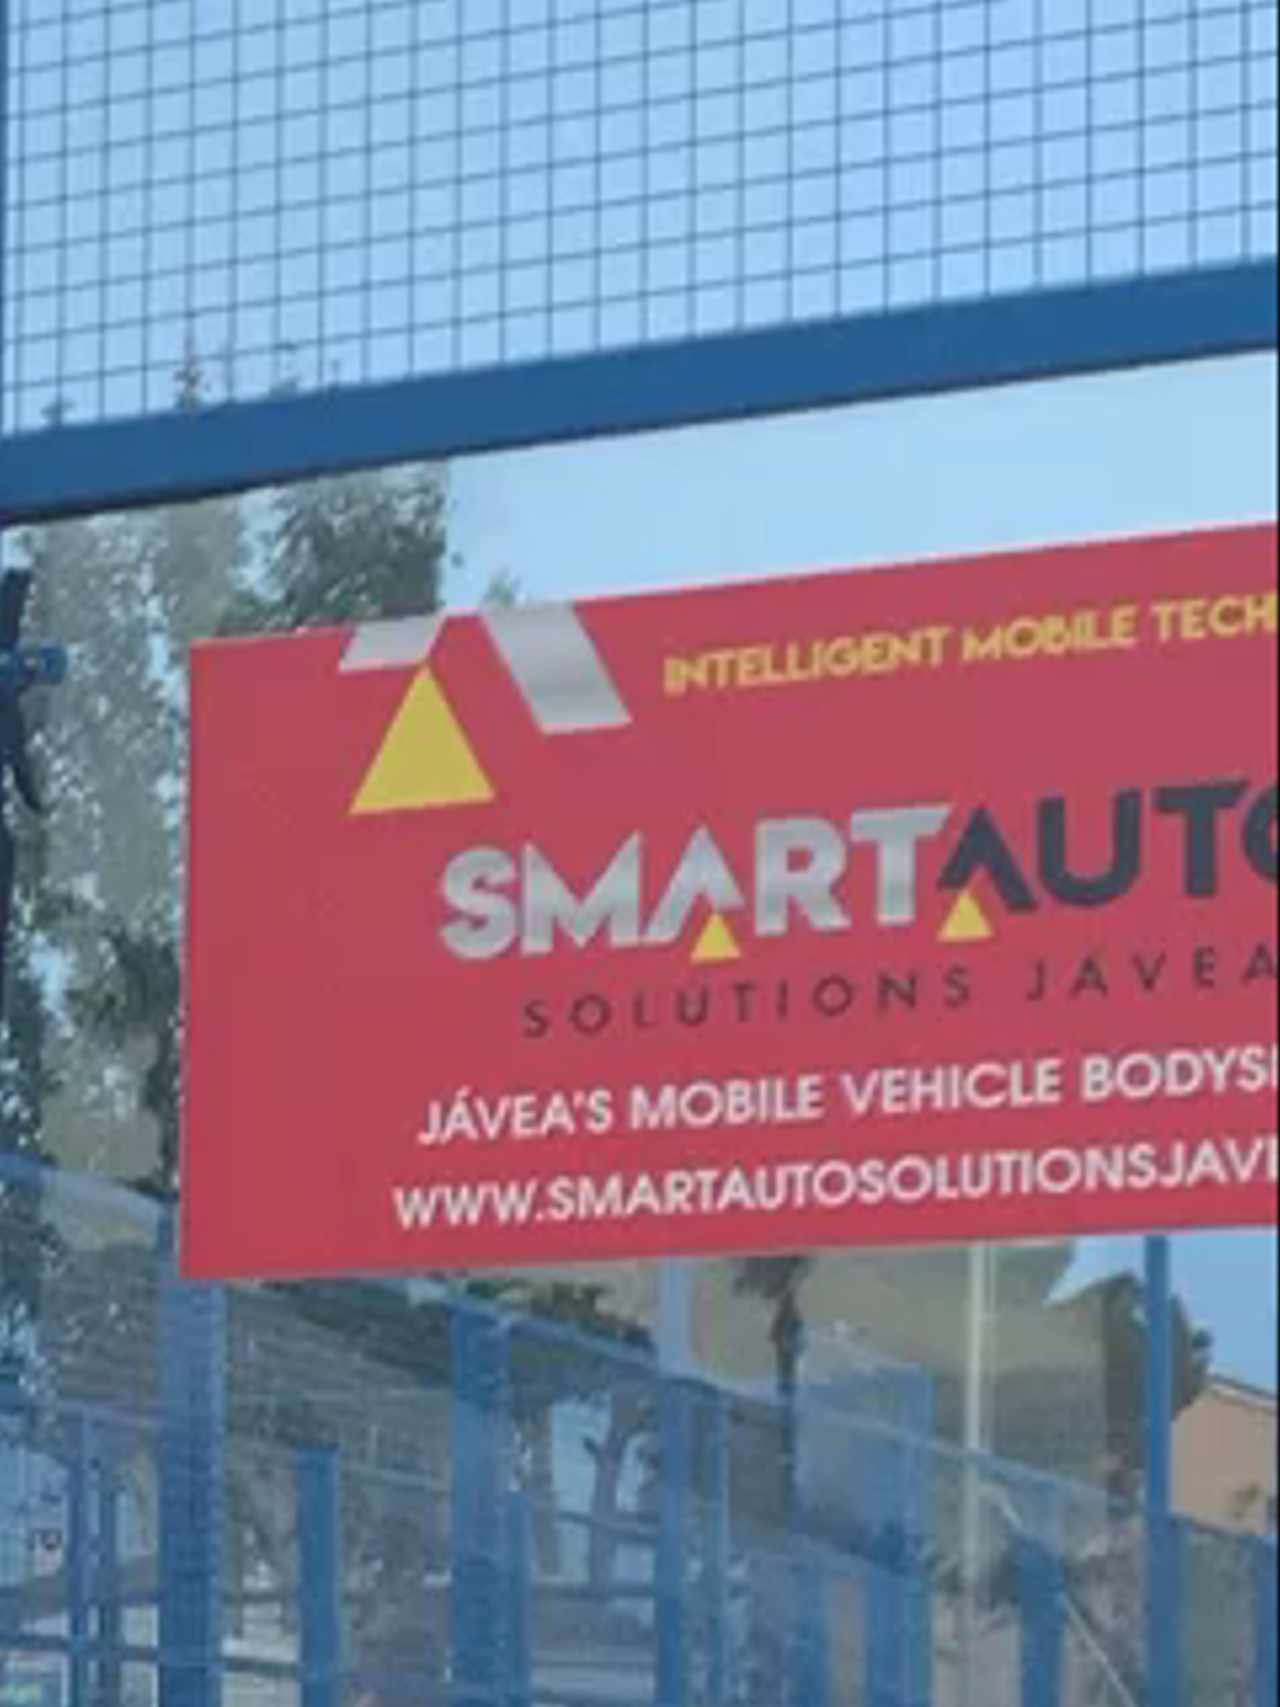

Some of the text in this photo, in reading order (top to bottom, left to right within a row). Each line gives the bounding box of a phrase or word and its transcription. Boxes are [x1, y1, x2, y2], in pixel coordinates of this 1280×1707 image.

[662, 626, 950, 695] INTELLIGENT
[962, 604, 1137, 662] MOBILE
[521, 963, 971, 1039] SOLUTIONS
[416, 1043, 1278, 1146] JÁVEA'S MOBILE VEHICLE BODYS
[392, 1136, 1278, 1230] WWW.SMARTAUTOSOLUTIONSJAV
